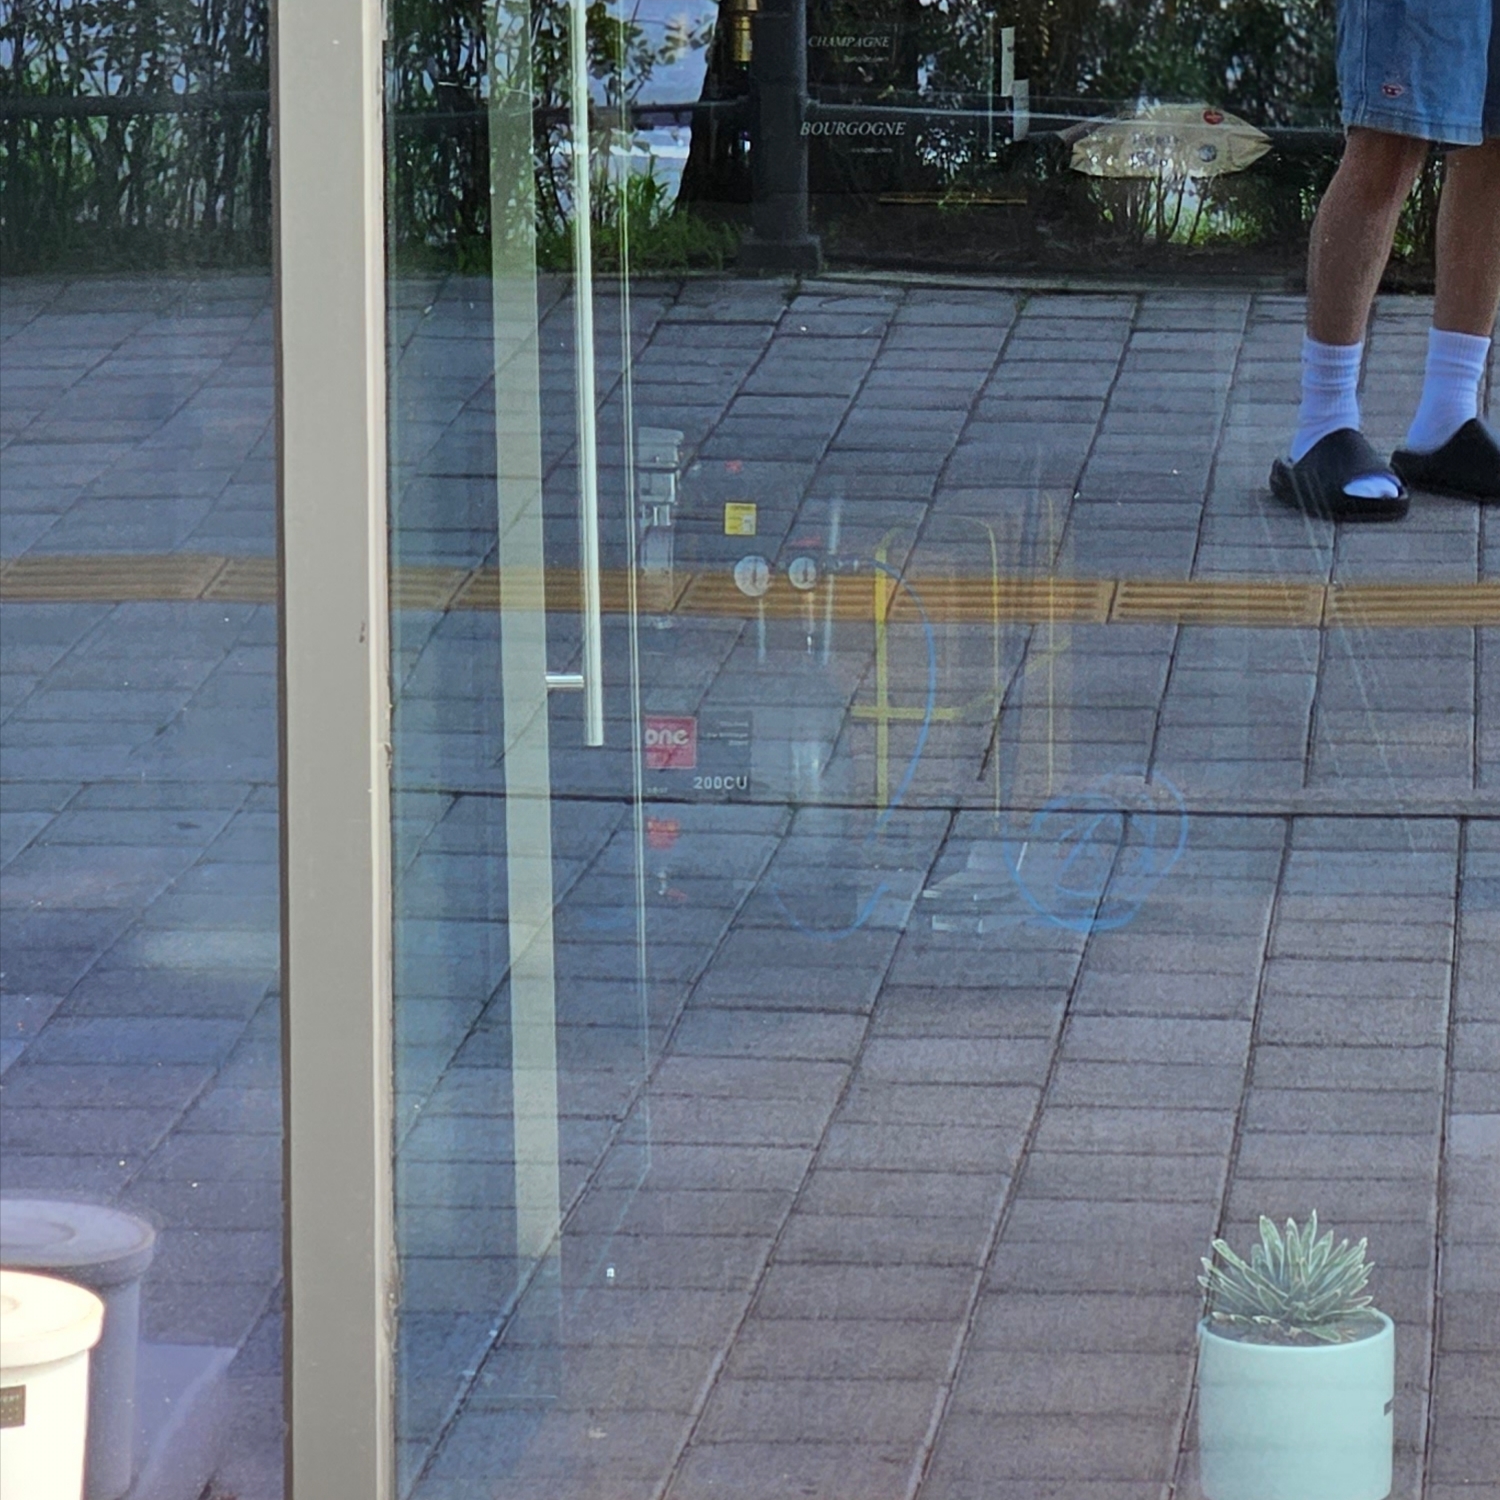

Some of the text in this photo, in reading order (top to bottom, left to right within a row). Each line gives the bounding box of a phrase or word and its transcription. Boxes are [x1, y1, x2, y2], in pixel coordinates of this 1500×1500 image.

[808, 35, 890, 48] CHAMPAGNE
[800, 121, 906, 136] BOURGOGNE
[693, 775, 748, 790] 200CU
